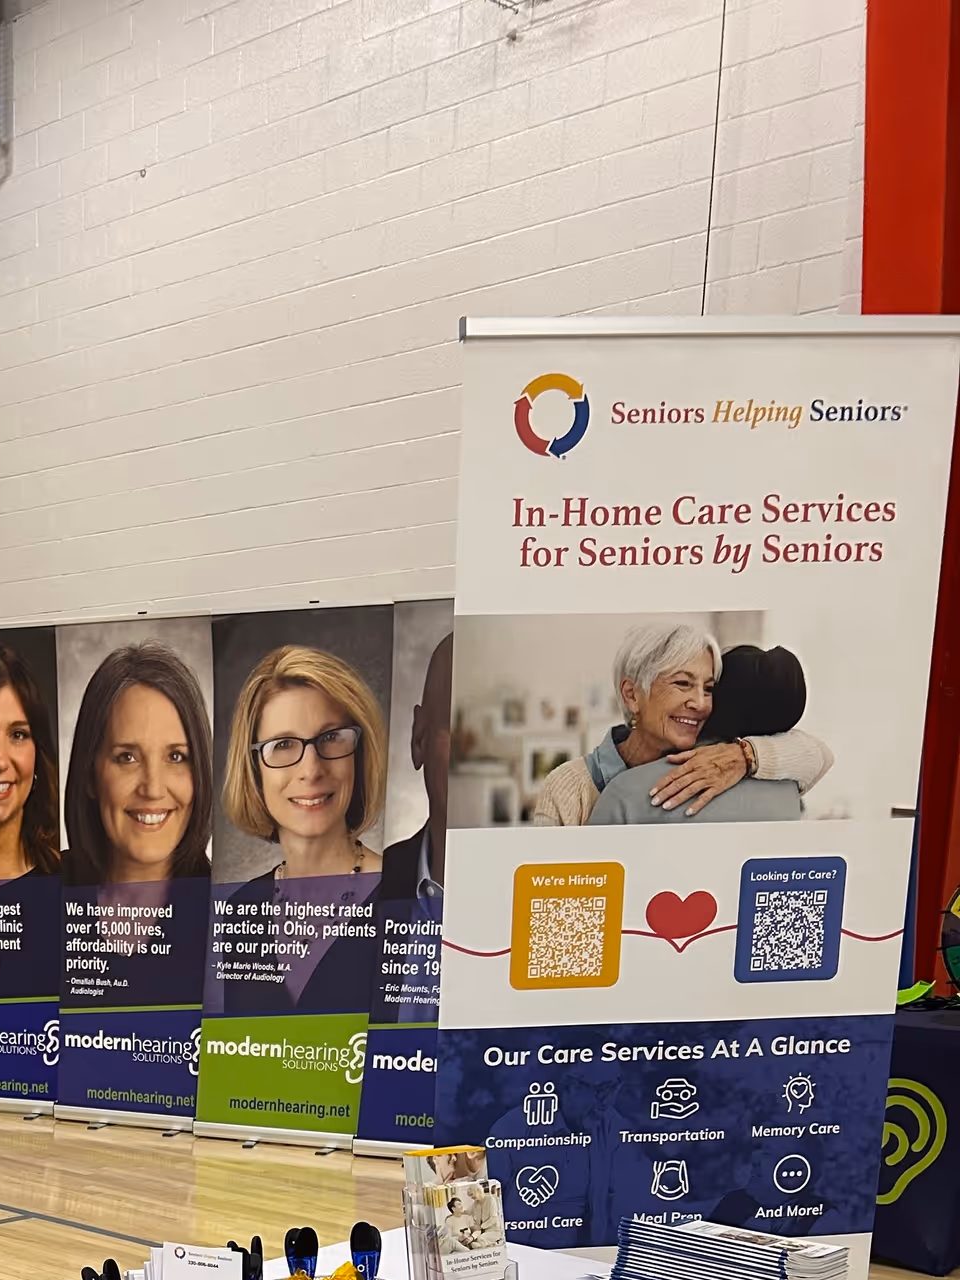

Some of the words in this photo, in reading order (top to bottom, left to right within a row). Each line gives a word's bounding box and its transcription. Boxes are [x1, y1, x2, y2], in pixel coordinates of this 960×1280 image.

[611, 402, 705, 426] Seniors
[711, 399, 803, 430] Helping
[512, 497, 662, 528] In-Home
[672, 495, 752, 526] Care
[761, 493, 897, 525] Services
[520, 537, 569, 568] for
[578, 537, 704, 568] Seniors
[712, 534, 752, 574] by
[762, 533, 884, 564] Seniors
[531, 875, 566, 887] We're
[568, 873, 608, 888] Hiring!
[750, 871, 789, 883] Looking
[791, 870, 806, 881] for
[808, 869, 838, 881] Care?
[66, 902, 84, 917] We
[86, 902, 115, 917] have
[117, 903, 173, 921] improved
[214, 900, 234, 916] We
[236, 902, 258, 916] are
[261, 901, 282, 917] the
[284, 901, 336, 920] highest
[338, 902, 374, 918] rated
[66, 922, 92, 935] over
[94, 920, 131, 937] 15,000
[134, 922, 166, 939] lives,
[213, 921, 265, 938] practice
[267, 920, 280, 936] in
[283, 920, 319, 939] Ohio,
[322, 922, 377, 939] patients
[66, 938, 135, 957] affordability
[137, 940, 148, 954] is
[150, 943, 172, 955] our
[212, 941, 233, 954] are
[235, 941, 259, 954] our
[261, 940, 311, 959] priority.
[382, 939, 436, 959] hearing
[66, 956, 110, 973] priority.
[381, 960, 419, 975] since
[422, 960, 441, 976] 19
[216, 971, 243, 981] Director
[243, 972, 252, 981] of
[251, 973, 285, 984] Audiology
[70, 987, 105, 997] Audiologist
[384, 983, 400, 993] Eric
[384, 994, 412, 1005] Modern
[64, 1029, 193, 1061] modernhearing
[206, 1035, 351, 1068] modernhearing
[483, 1046, 531, 1066] Our
[538, 1045, 594, 1065] Care
[601, 1040, 705, 1063] Services
[711, 1039, 740, 1060] At
[744, 1038, 765, 1058] A
[770, 1036, 851, 1056] Glance
[132, 1052, 183, 1065] SOLUTIONS
[282, 1059, 339, 1072] SOLUTIONS
[86, 1087, 195, 1109] modernhearing.net
[229, 1096, 351, 1119] modernhearing.net
[619, 1127, 725, 1146] Transportation
[751, 1124, 806, 1140] Memory
[809, 1122, 841, 1136] Care
[485, 1133, 592, 1151] Companionship
[632, 1211, 667, 1225] Meal
[754, 1206, 783, 1219] And
[786, 1203, 824, 1218] More!
[552, 1216, 583, 1229] Care
